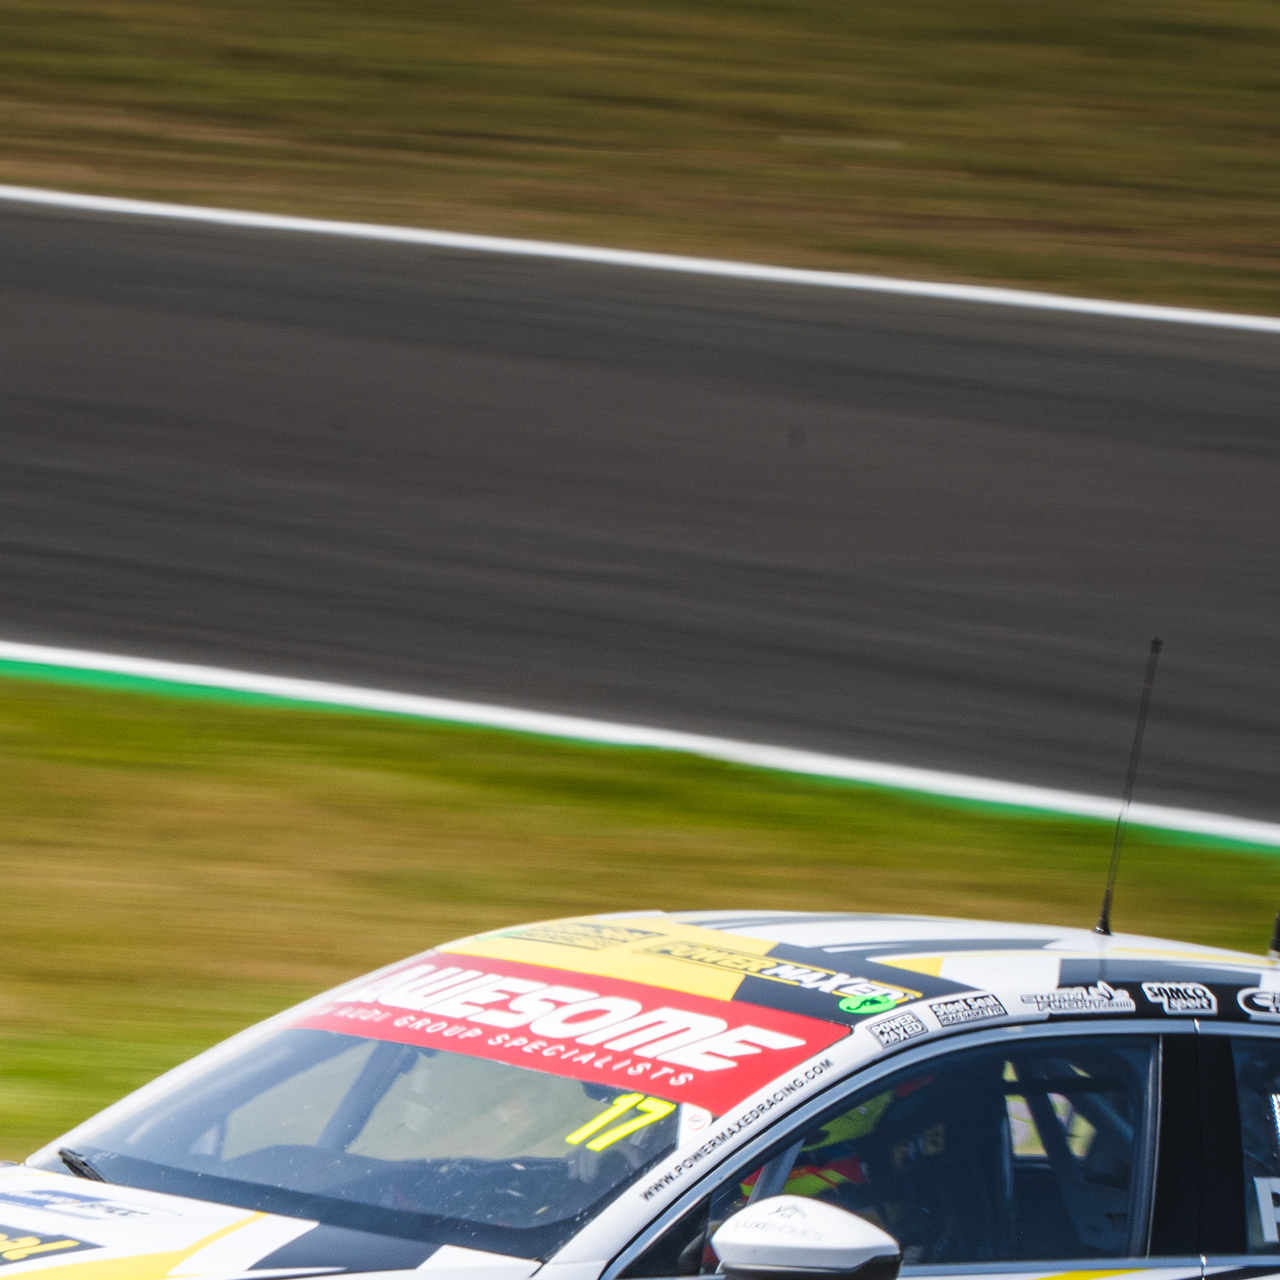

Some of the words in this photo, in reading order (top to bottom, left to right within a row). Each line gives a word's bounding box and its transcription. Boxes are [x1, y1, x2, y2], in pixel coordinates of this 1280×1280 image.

[332, 963, 807, 1073] AWESOME
[394, 1012, 482, 1041] GROUP
[488, 1032, 694, 1087] SPECIALISTS
[871, 1014, 916, 1034] POWER
[879, 1022, 922, 1043] MAXED
[566, 1092, 676, 1152] 17
[640, 1058, 834, 1202] WWW.POWERMAXEDRACING.COM
